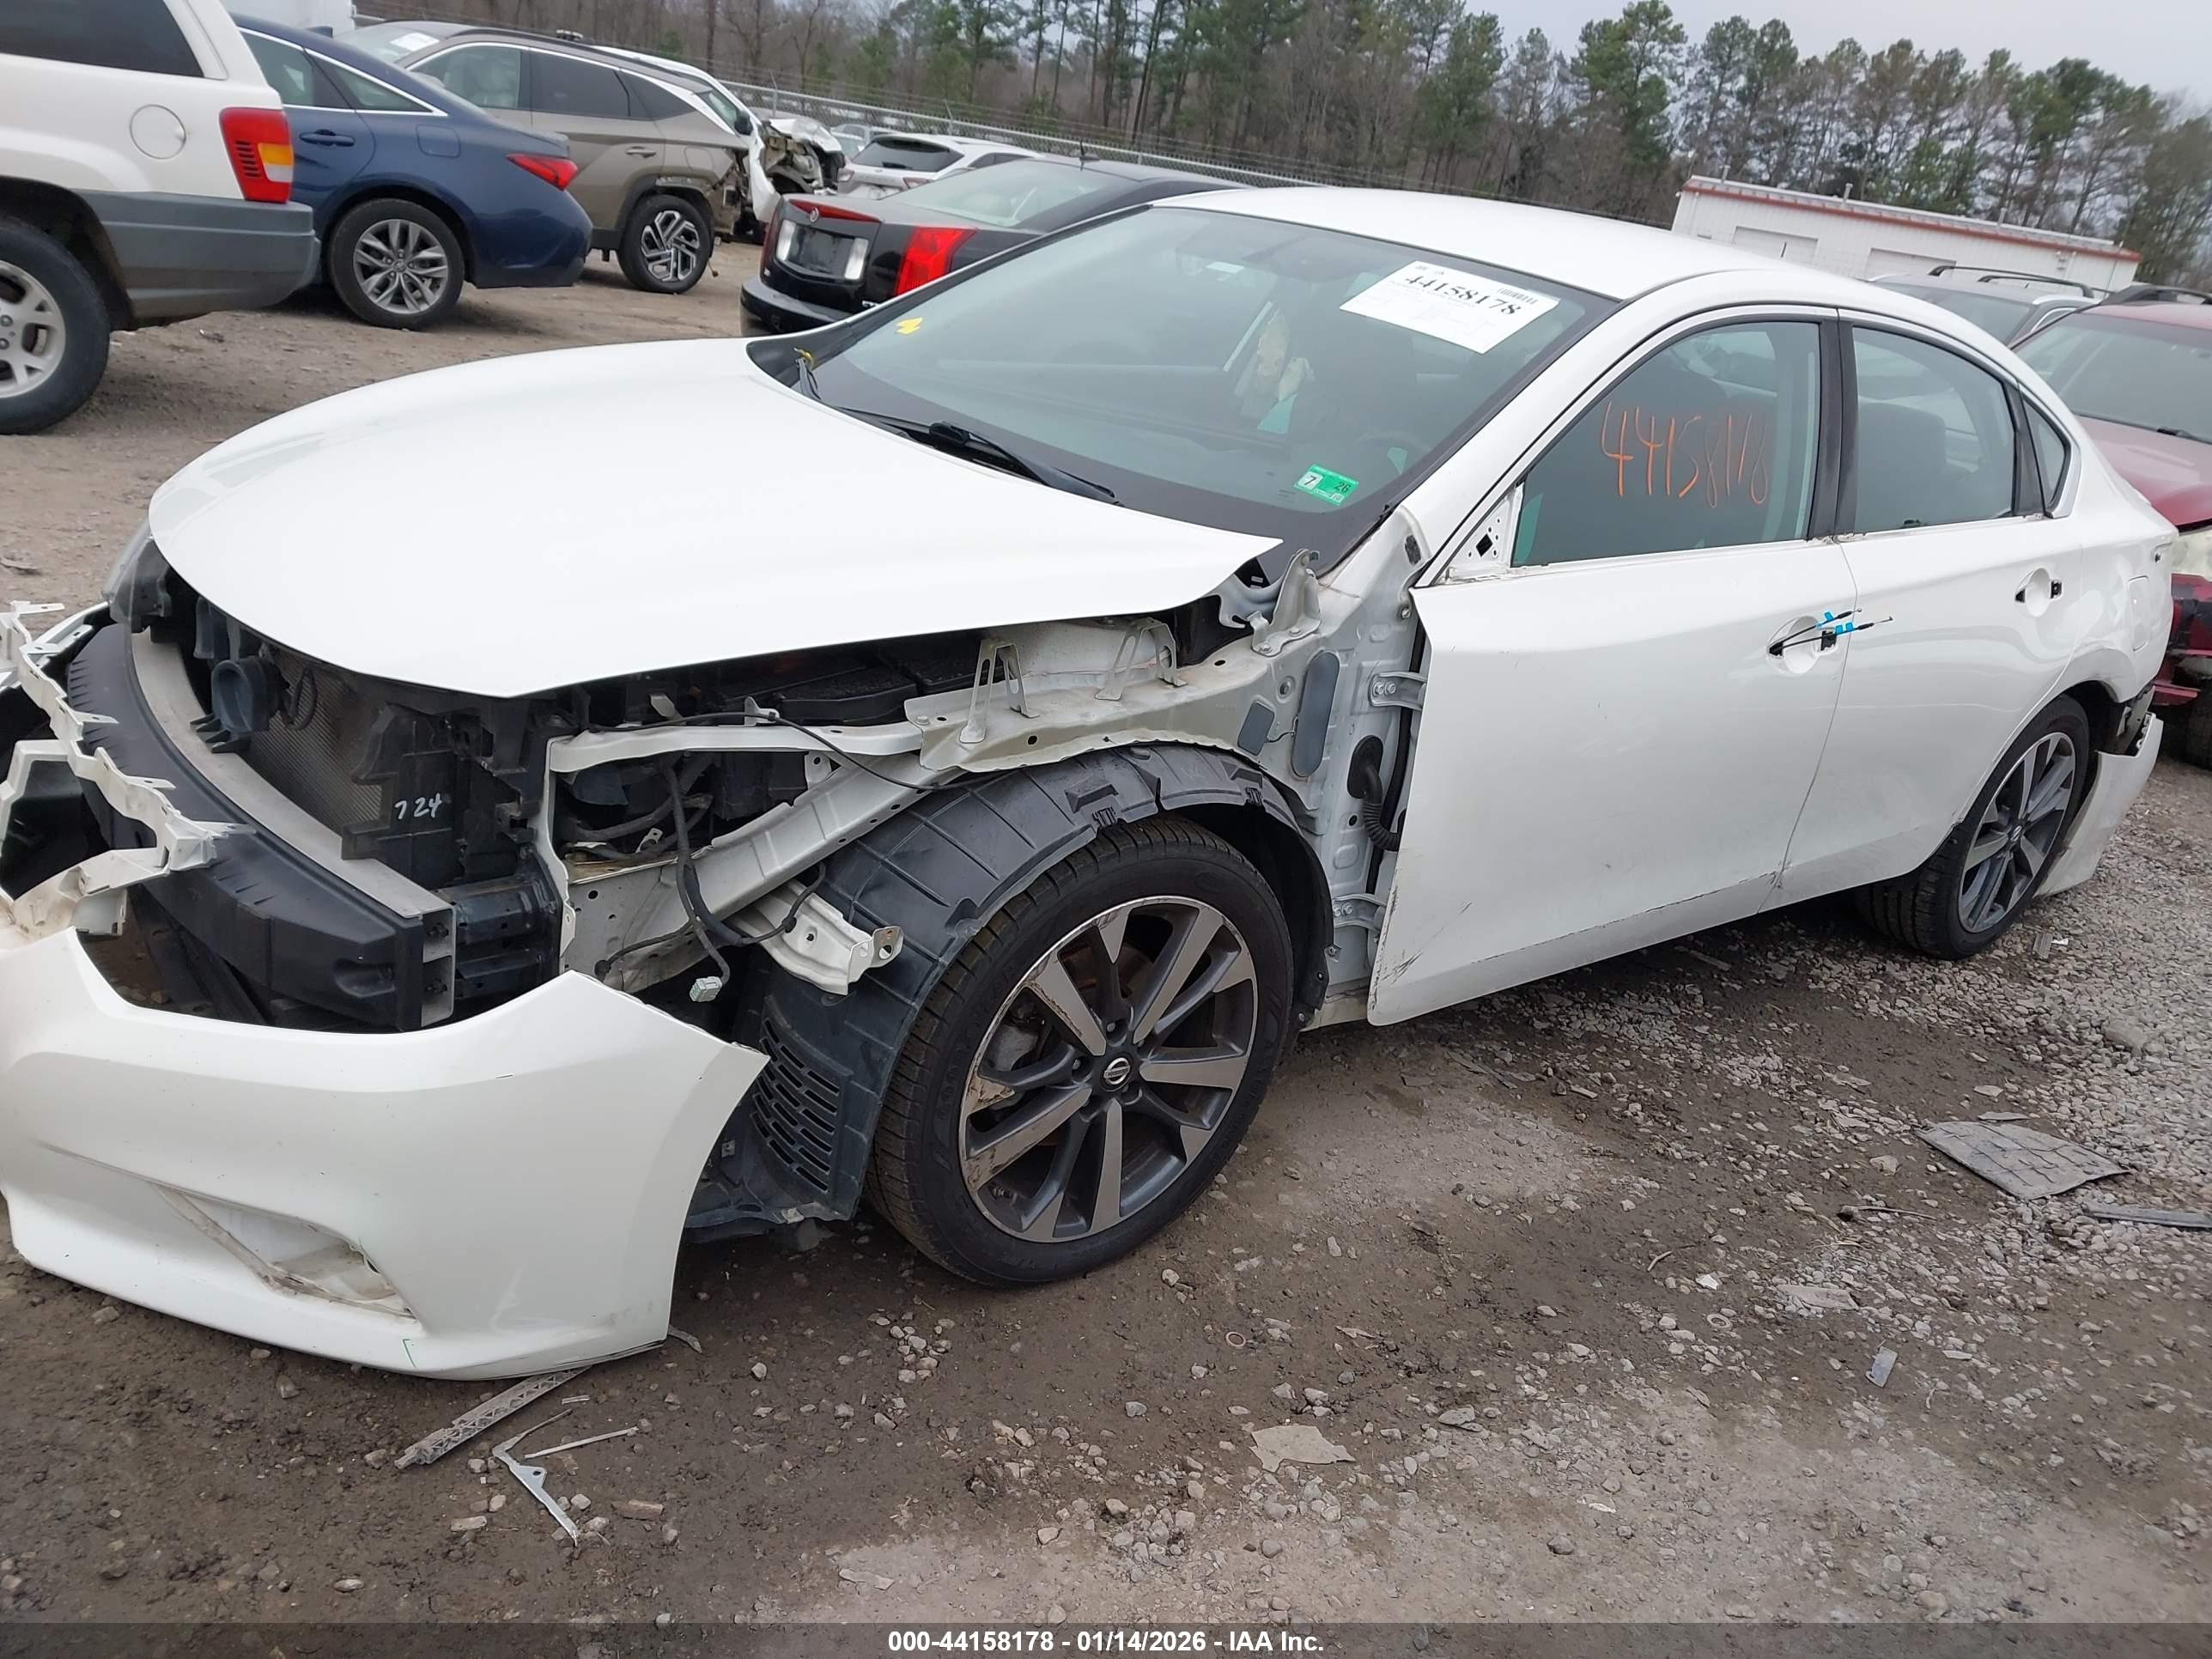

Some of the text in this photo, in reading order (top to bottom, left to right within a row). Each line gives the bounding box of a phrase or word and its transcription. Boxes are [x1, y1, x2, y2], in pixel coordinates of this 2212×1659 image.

[1405, 276, 1522, 315] 44158178
[1304, 475, 1316, 486] 7
[1334, 481, 1352, 493] 26
